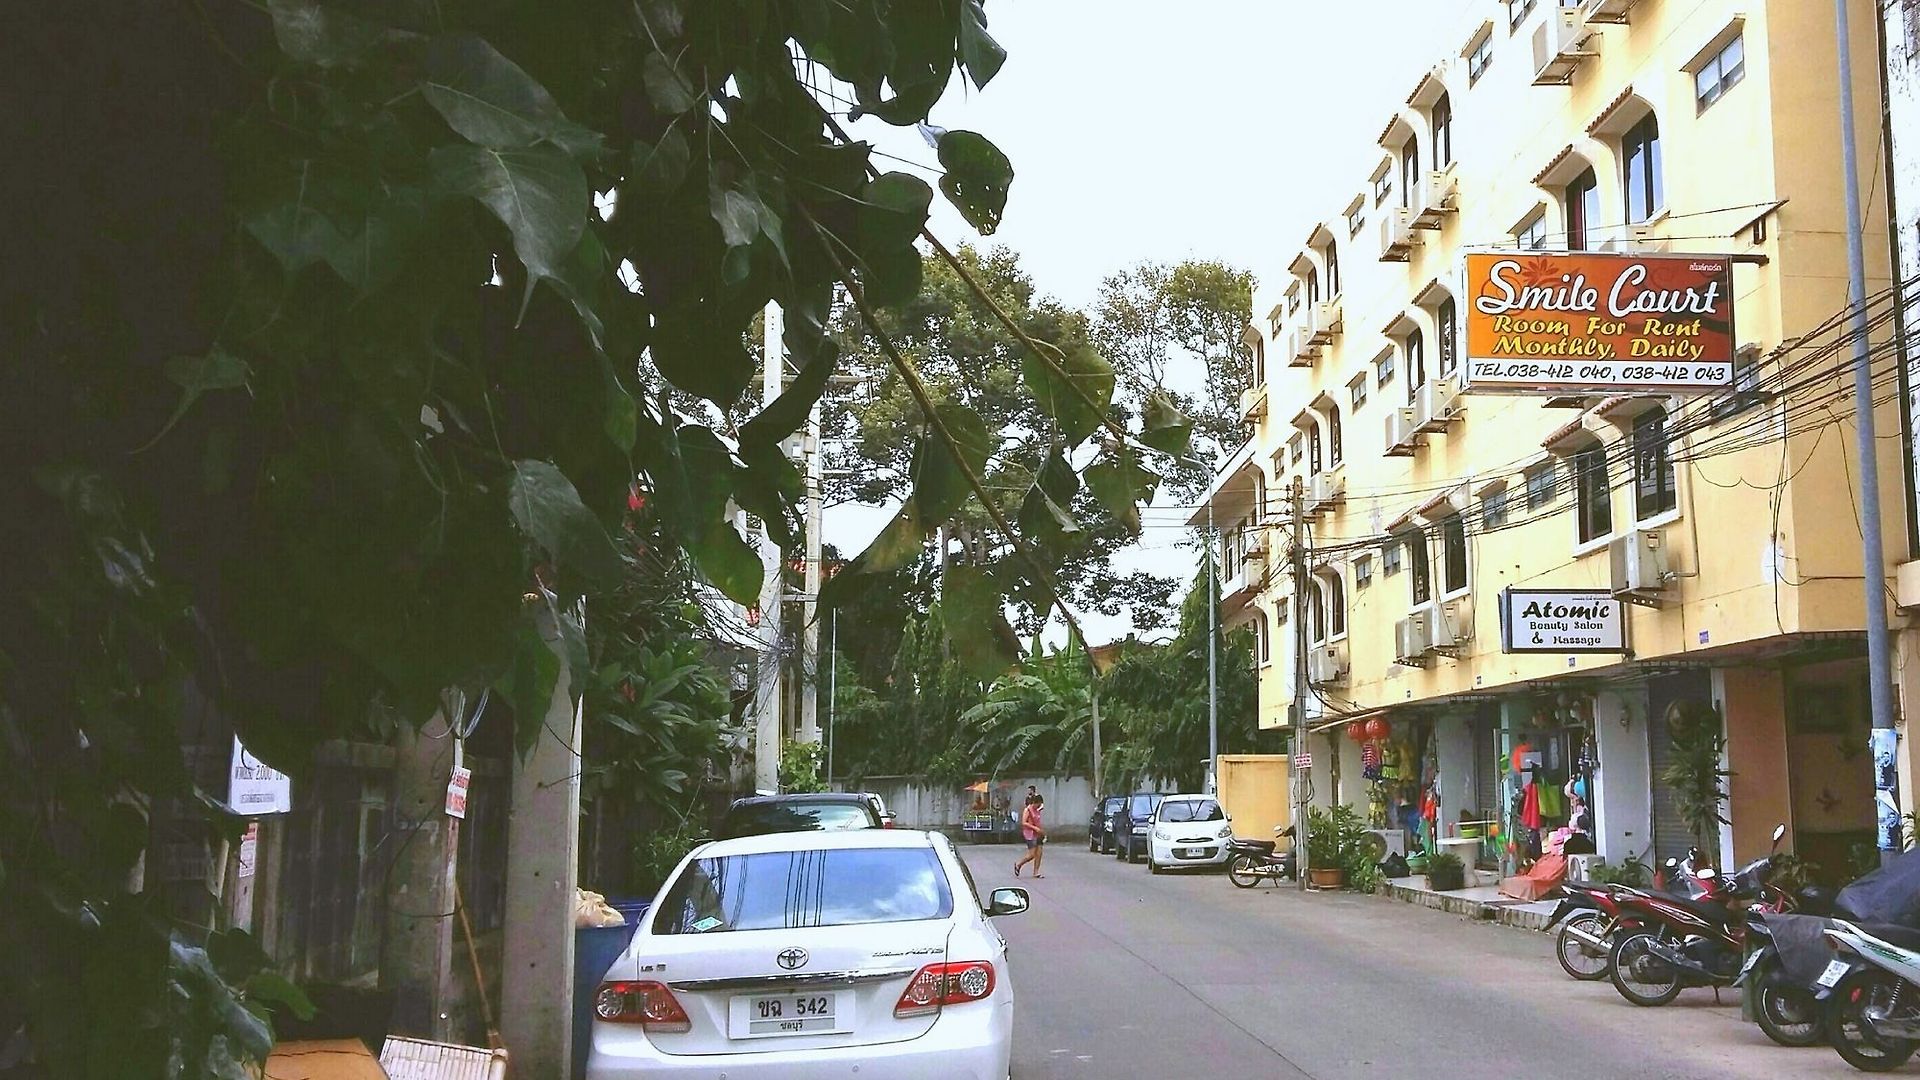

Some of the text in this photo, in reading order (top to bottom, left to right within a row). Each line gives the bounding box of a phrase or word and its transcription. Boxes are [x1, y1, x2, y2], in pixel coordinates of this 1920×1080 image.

[1475, 261, 1719, 318] Smile Court
[1493, 315, 1701, 336] Room For Rent
[1630, 338, 1705, 361] Daily
[1580, 365, 1616, 382] 040,
[1622, 366, 1689, 380] 038-412
[1695, 366, 1725, 381] 043
[1521, 600, 1610, 620] Atomic
[1529, 620, 1604, 632] Beauty Salon
[1531, 631, 1544, 645] &
[796, 997, 828, 1015] 542
